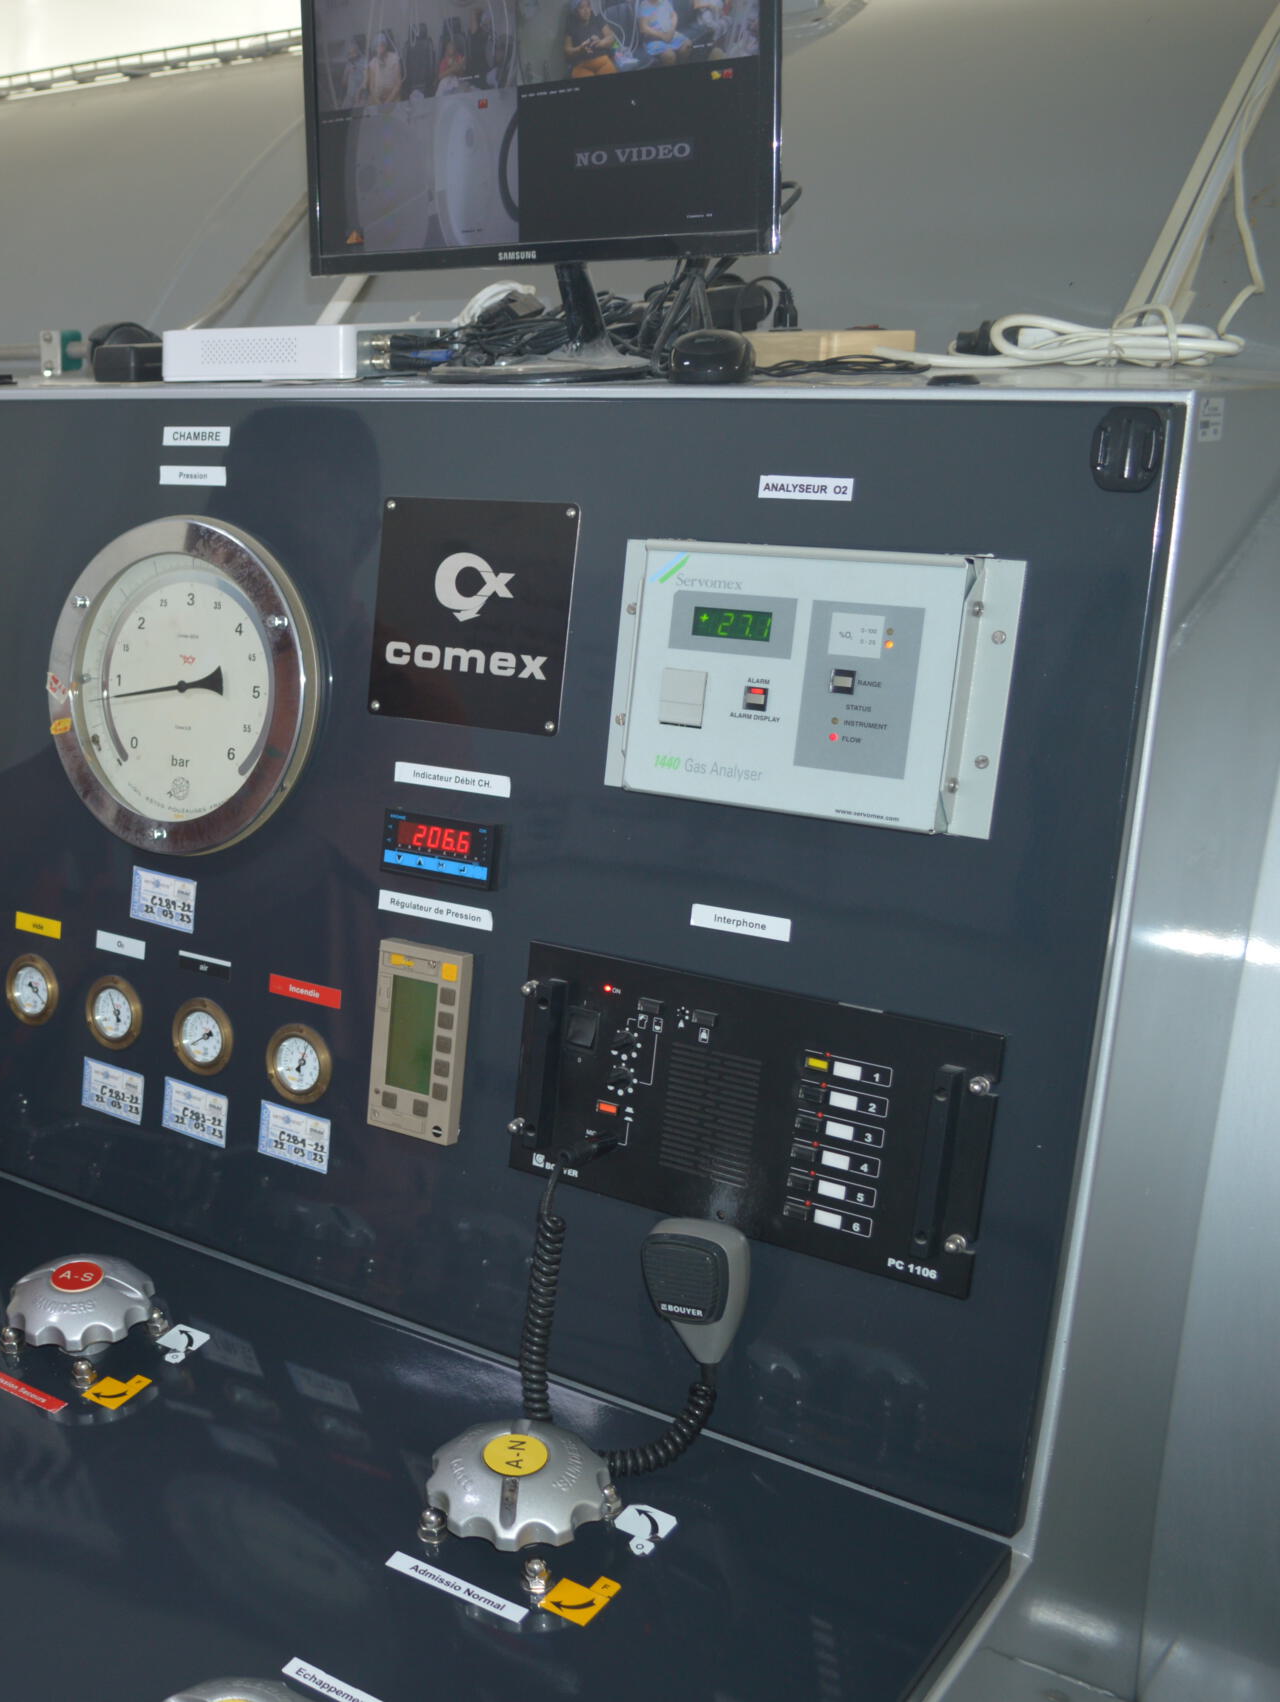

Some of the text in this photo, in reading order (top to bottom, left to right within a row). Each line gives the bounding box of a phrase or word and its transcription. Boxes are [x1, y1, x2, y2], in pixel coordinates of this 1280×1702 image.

[575, 142, 691, 167] NO VIDEO
[497, 250, 537, 261] SAMSUNG
[172, 431, 221, 441] CHAMBRE
[178, 471, 208, 480] Pression
[763, 482, 848, 495] ANALYSEUR O2
[675, 573, 744, 590] Servomex
[187, 592, 195, 606] 3
[137, 616, 146, 630] 2
[234, 623, 243, 636] 4
[385, 641, 549, 681] comex
[116, 674, 122, 687] 1
[747, 677, 770, 685] ALARM
[857, 679, 882, 688] RANGE
[252, 685, 261, 699] 5
[845, 704, 872, 712] STATUS
[729, 712, 780, 723] ALARM DISPLAY
[843, 719, 888, 731] INSTRUMENT
[130, 736, 138, 749] 0
[841, 735, 862, 744] FLOW
[227, 747, 236, 761] 6
[171, 755, 191, 768] bar
[655, 754, 763, 782] 1440 Gas Analyser
[412, 770, 453, 783] Indicateur
[454, 776, 476, 787] Débit
[834, 808, 900, 822] www.servomex.com
[389, 897, 482, 923] Régulateur de Pression
[713, 914, 767, 930] Interphone
[198, 963, 209, 971] air
[288, 984, 320, 999] Incendie
[873, 1072, 881, 1082] 1
[868, 1103, 877, 1113] 2
[864, 1133, 873, 1143] 3
[545, 1161, 579, 1178] BOYER
[860, 1163, 869, 1173] 4
[856, 1193, 865, 1202] 5
[852, 1222, 861, 1232] 6
[887, 1257, 938, 1280] PC 1106
[58, 1270, 95, 1282] A-S
[668, 1304, 703, 1317] BOUYER
[19, 1387, 47, 1403] Secours
[506, 1440, 527, 1469] A-N
[409, 1563, 506, 1612] Admissio Normal
[295, 1667, 365, 1702] Echappeme
